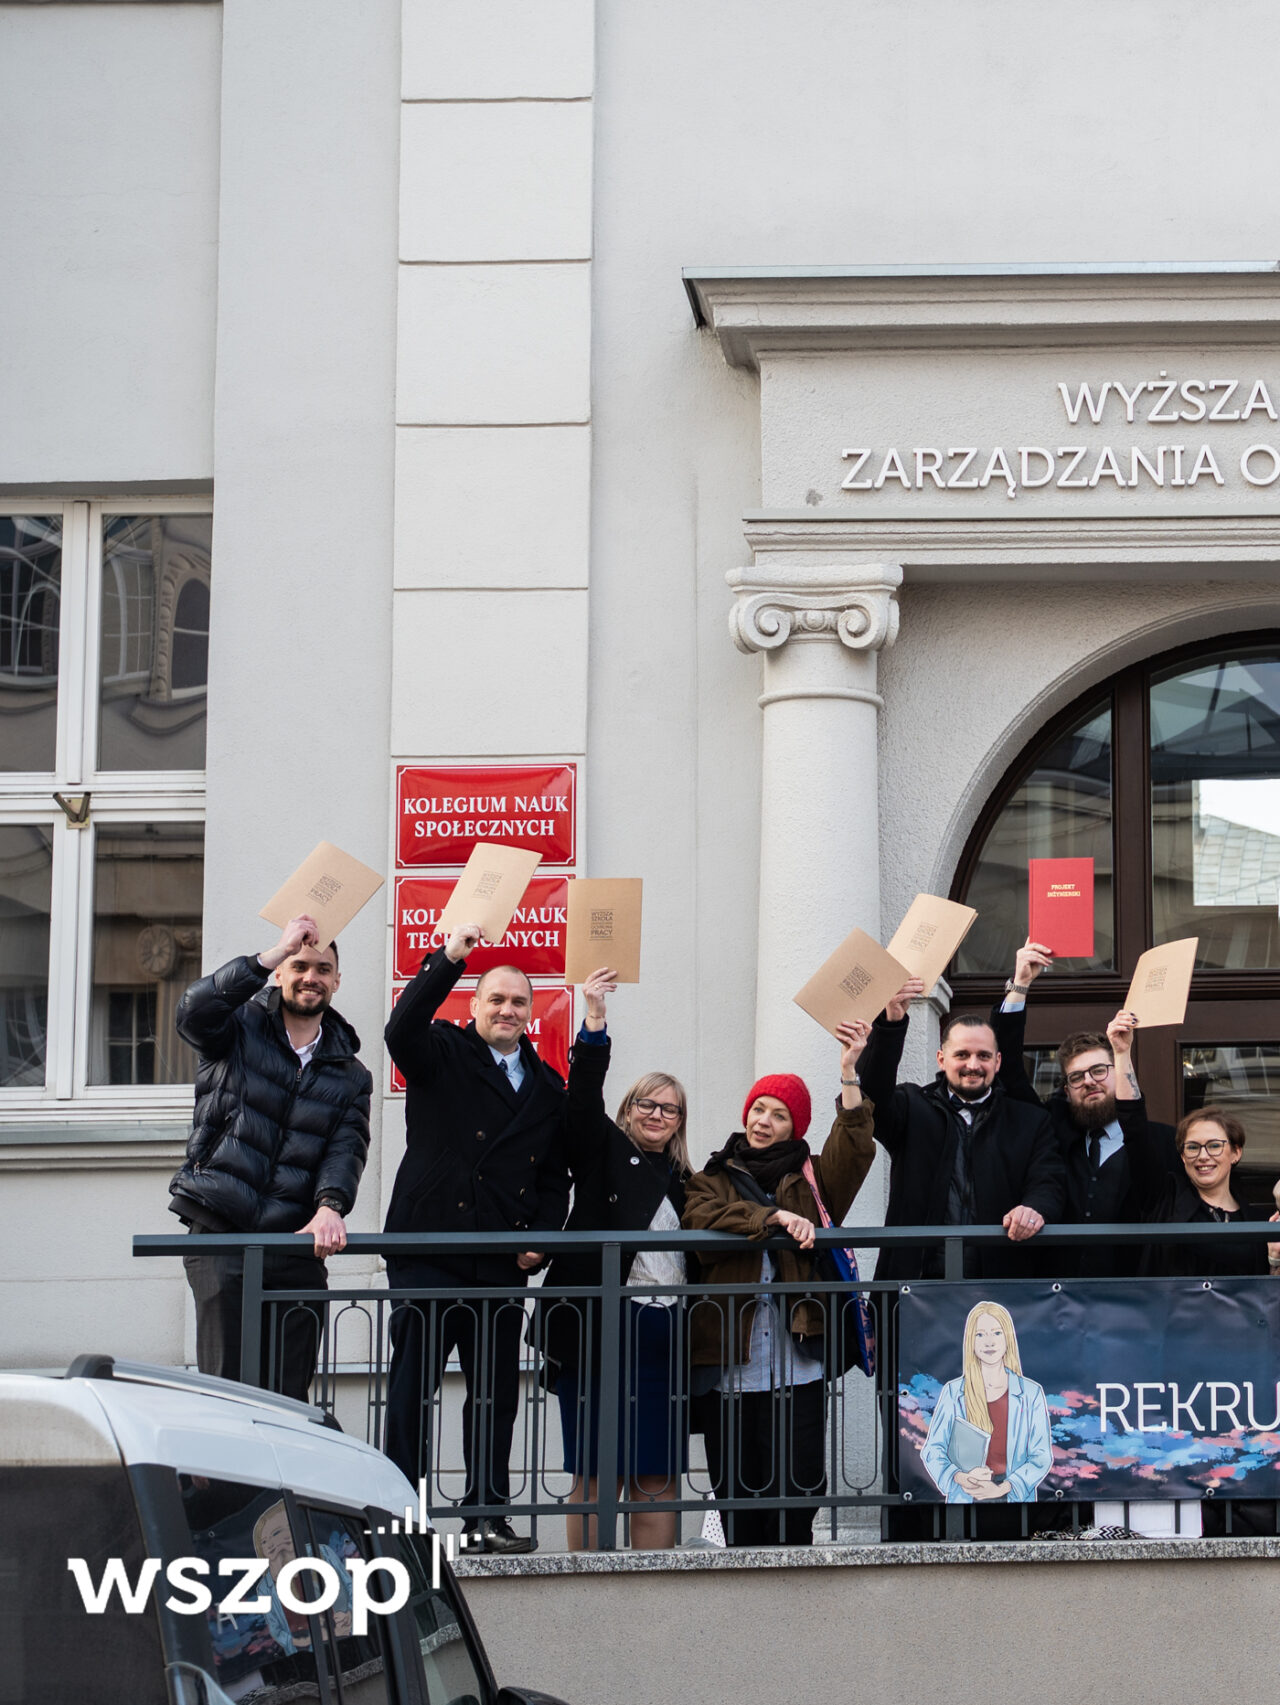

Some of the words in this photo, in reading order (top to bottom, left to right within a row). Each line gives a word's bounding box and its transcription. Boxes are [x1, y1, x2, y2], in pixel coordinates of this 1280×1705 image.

[1058, 370, 1279, 424] WYŻSZA
[841, 444, 1225, 498] ZARZĄDZANIA
[403, 796, 507, 814] KOLEGIUM
[514, 795, 568, 812] NAUK
[414, 819, 555, 837] SPOŁECZNYCH
